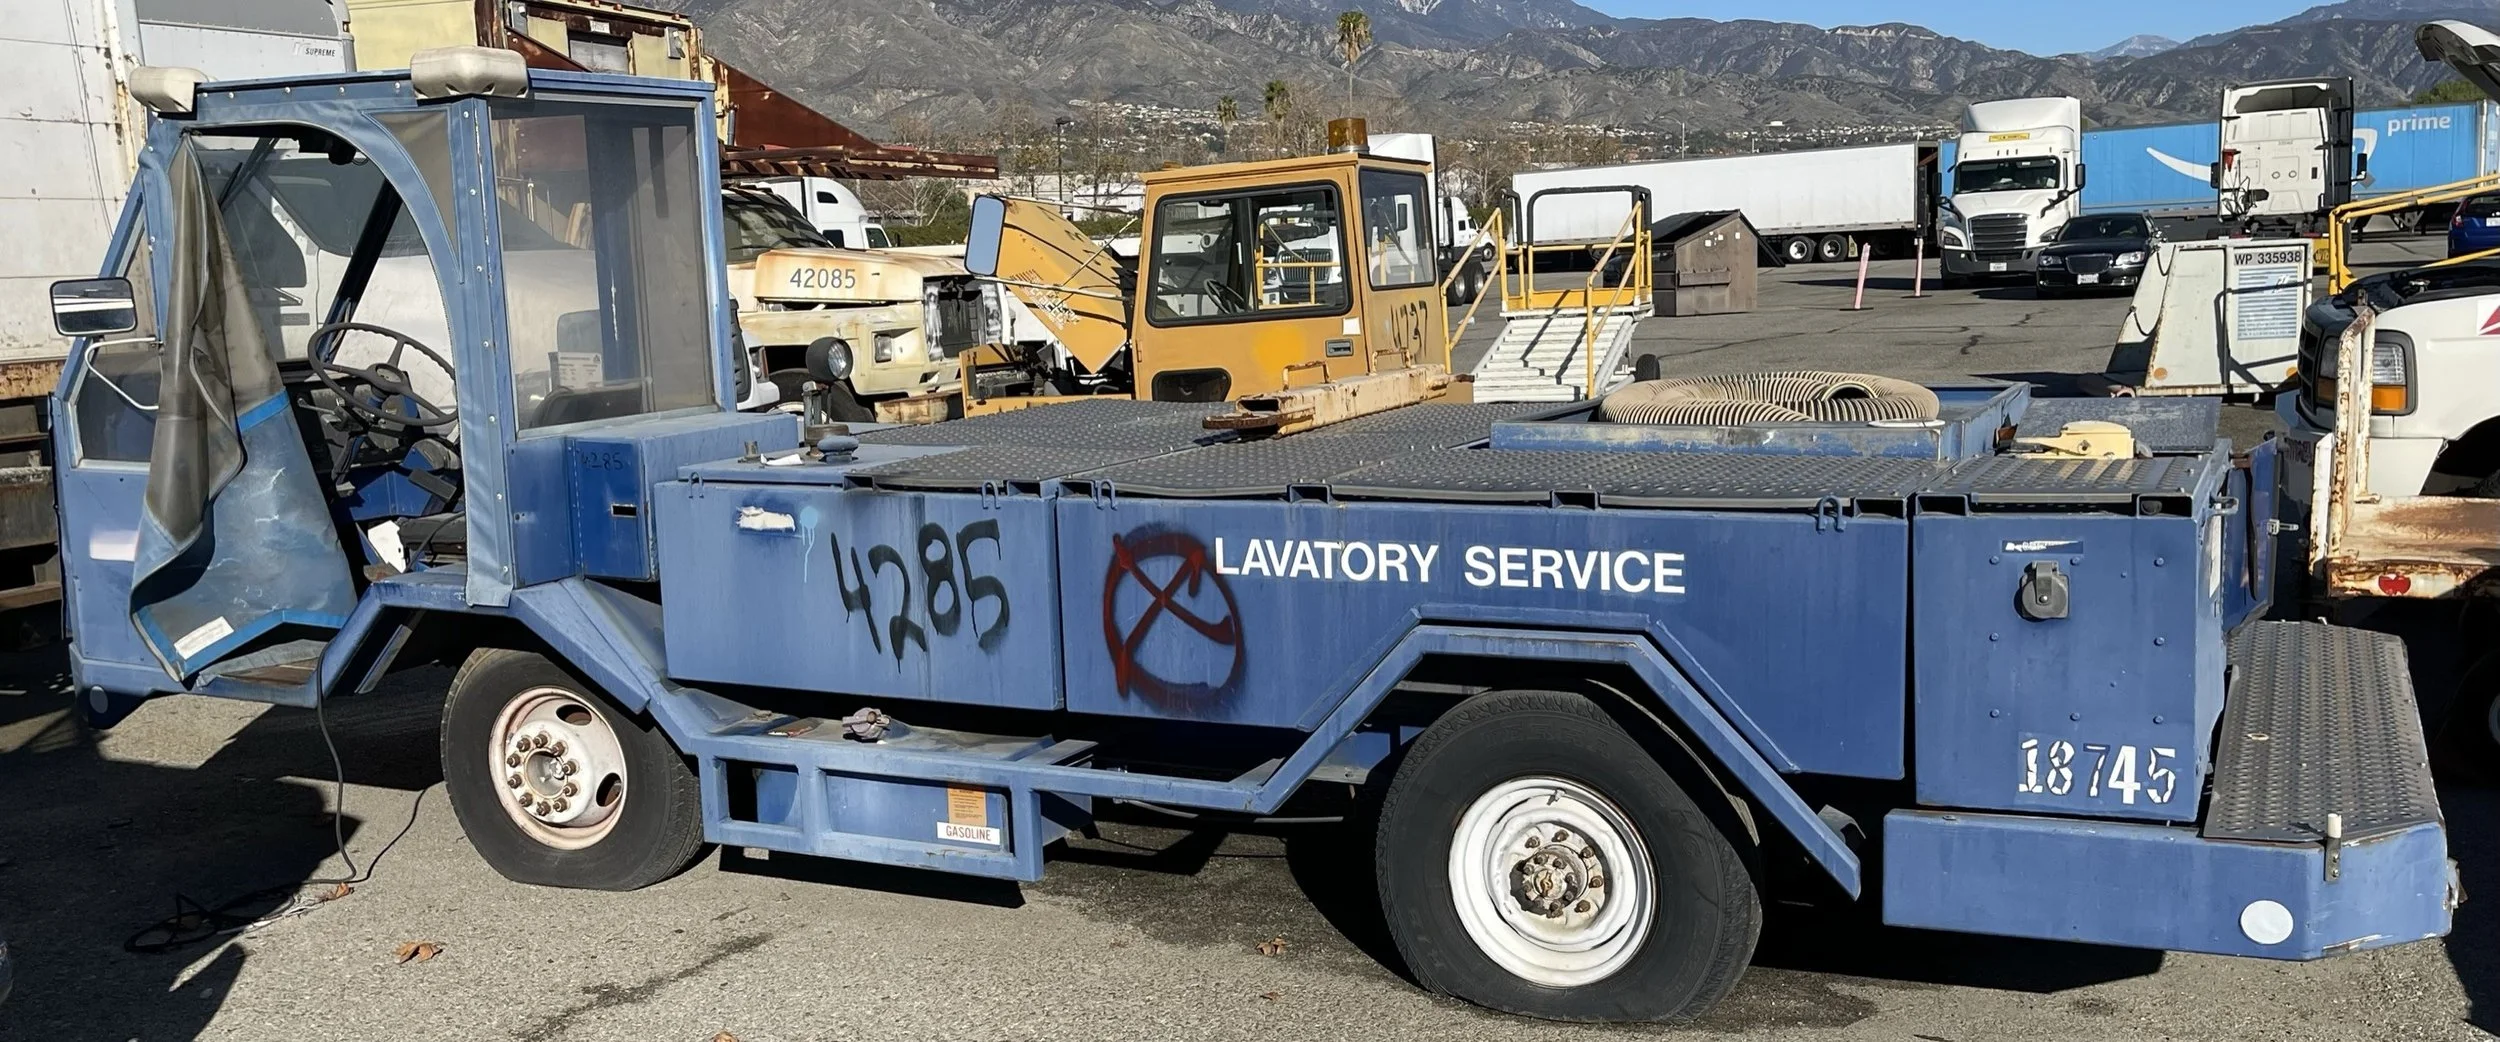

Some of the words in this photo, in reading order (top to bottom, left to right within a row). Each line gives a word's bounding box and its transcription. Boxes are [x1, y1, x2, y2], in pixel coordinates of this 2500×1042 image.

[305, 47, 336, 57] SUPREME
[2387, 113, 2451, 137] prime
[2234, 253, 2253, 265] WP
[2257, 250, 2302, 265] 335938
[789, 268, 856, 289] 42085
[1215, 537, 1439, 583] LAVATORY
[1463, 545, 1686, 595] SERVICE
[830, 518, 1010, 664] 4285
[2018, 738, 2177, 805] 18745
[945, 825, 991, 841] GASOLINE
